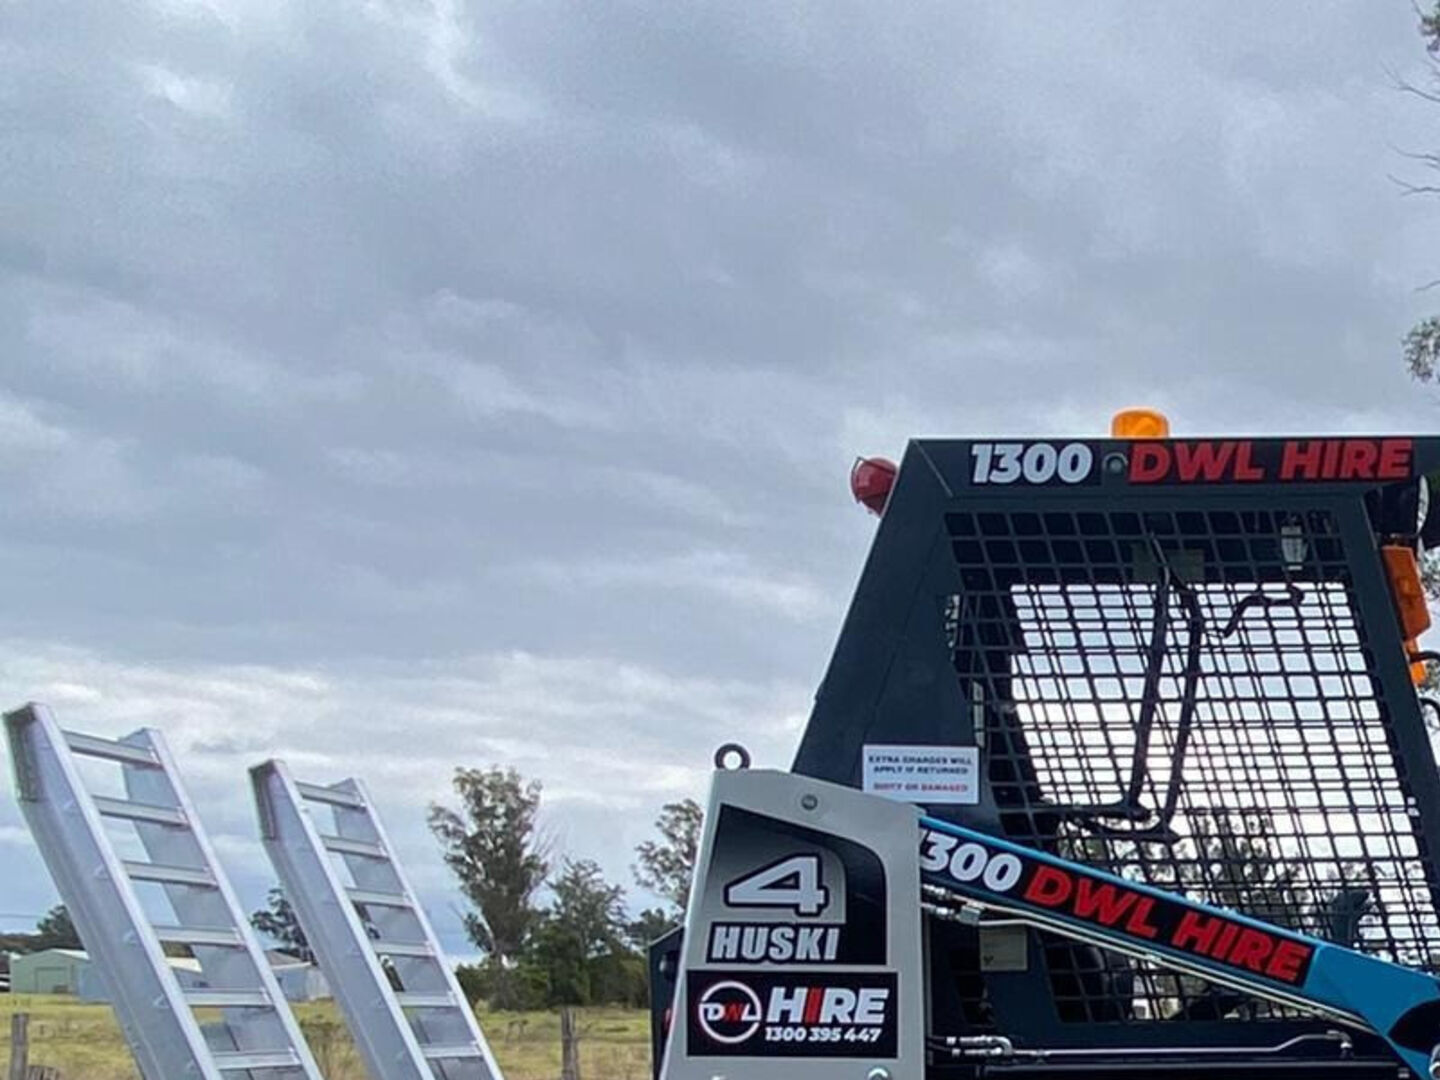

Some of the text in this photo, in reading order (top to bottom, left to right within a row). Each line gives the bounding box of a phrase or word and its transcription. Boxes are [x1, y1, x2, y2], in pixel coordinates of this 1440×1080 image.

[970, 439, 1412, 484] 1300 DWL HIRE
[868, 755, 972, 765] EXTRA CHARGES WILL
[873, 765, 903, 774] APPLY
[917, 766, 969, 775] RETURNED
[873, 782, 969, 792] DIRTY OR DAMAGED
[726, 854, 827, 915] 4
[921, 828, 1311, 984] 300 DWL HIRE
[711, 925, 840, 961] HUSKI
[704, 986, 890, 1025] DWL HIRE
[764, 1027, 883, 1042] 1300 395 447
